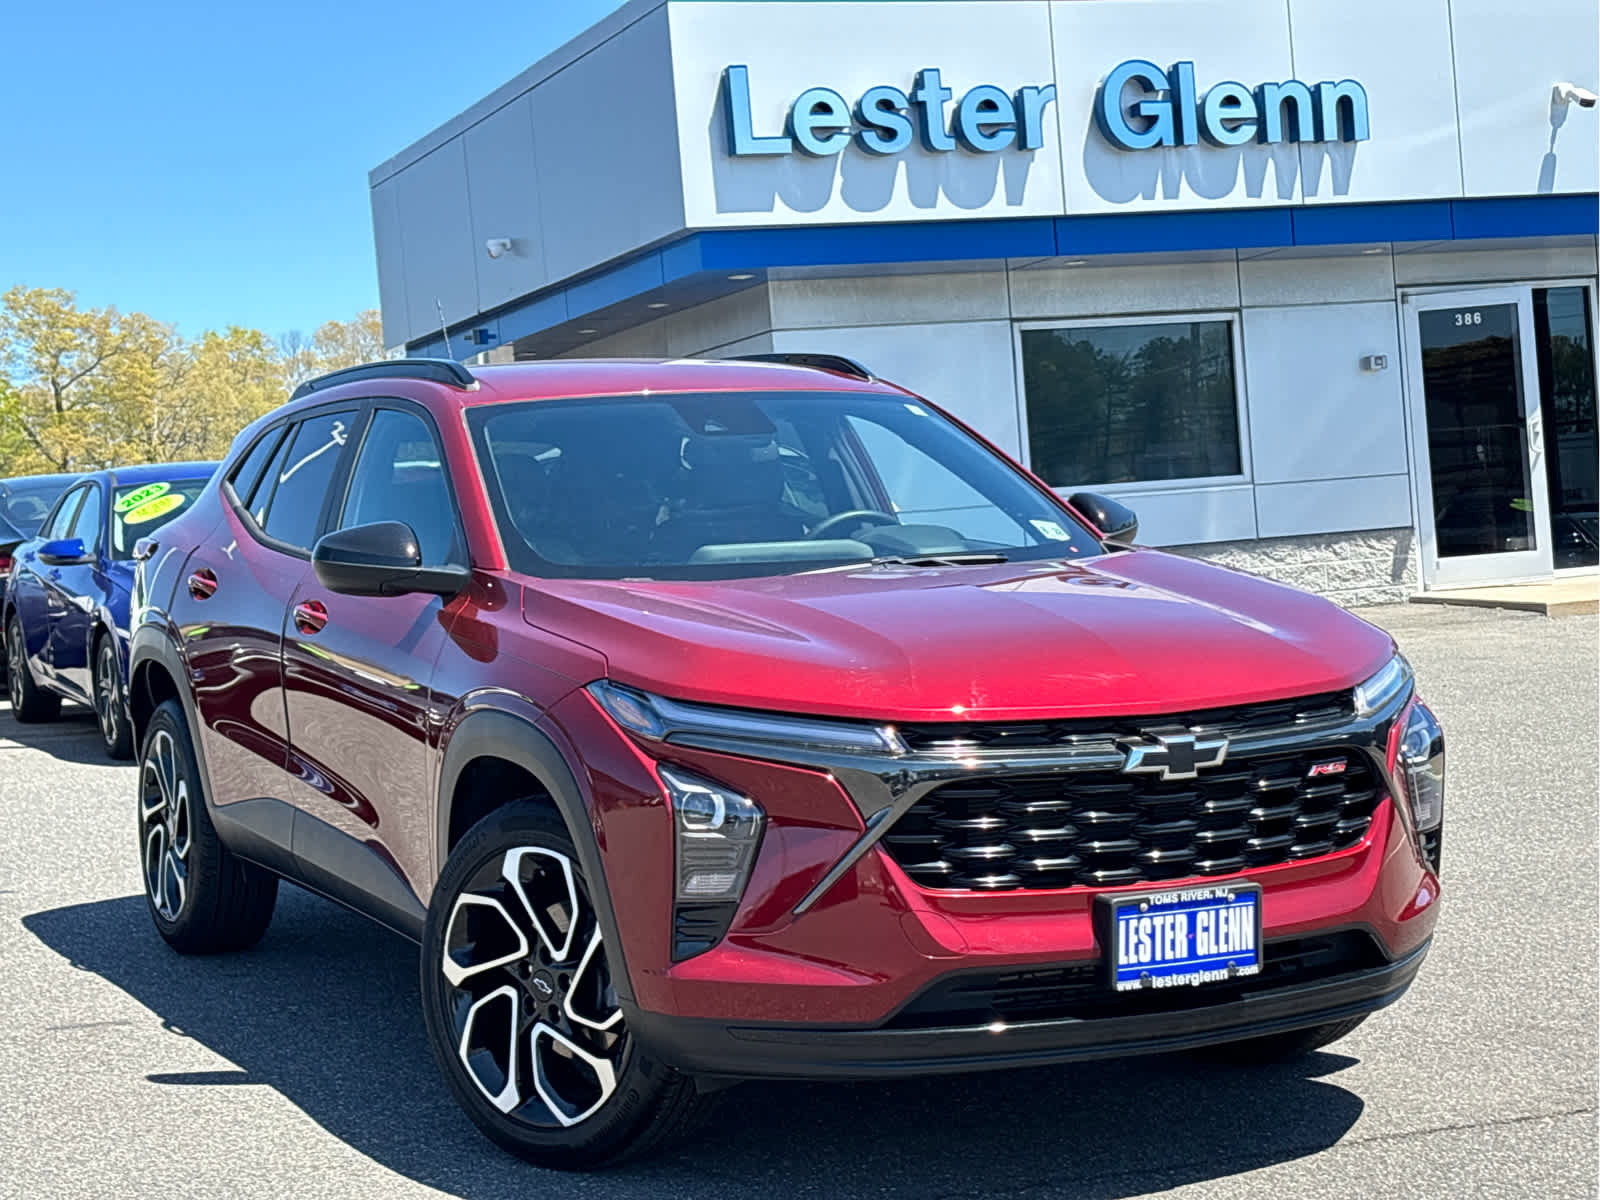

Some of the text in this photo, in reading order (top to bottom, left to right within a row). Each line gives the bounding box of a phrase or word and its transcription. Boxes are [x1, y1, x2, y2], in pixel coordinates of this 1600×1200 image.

[722, 59, 1369, 157] Lester Glenn
[1455, 312, 1482, 326] 386
[1149, 893, 1179, 905] TOMS
[1118, 905, 1255, 965] LESTER GLENN
